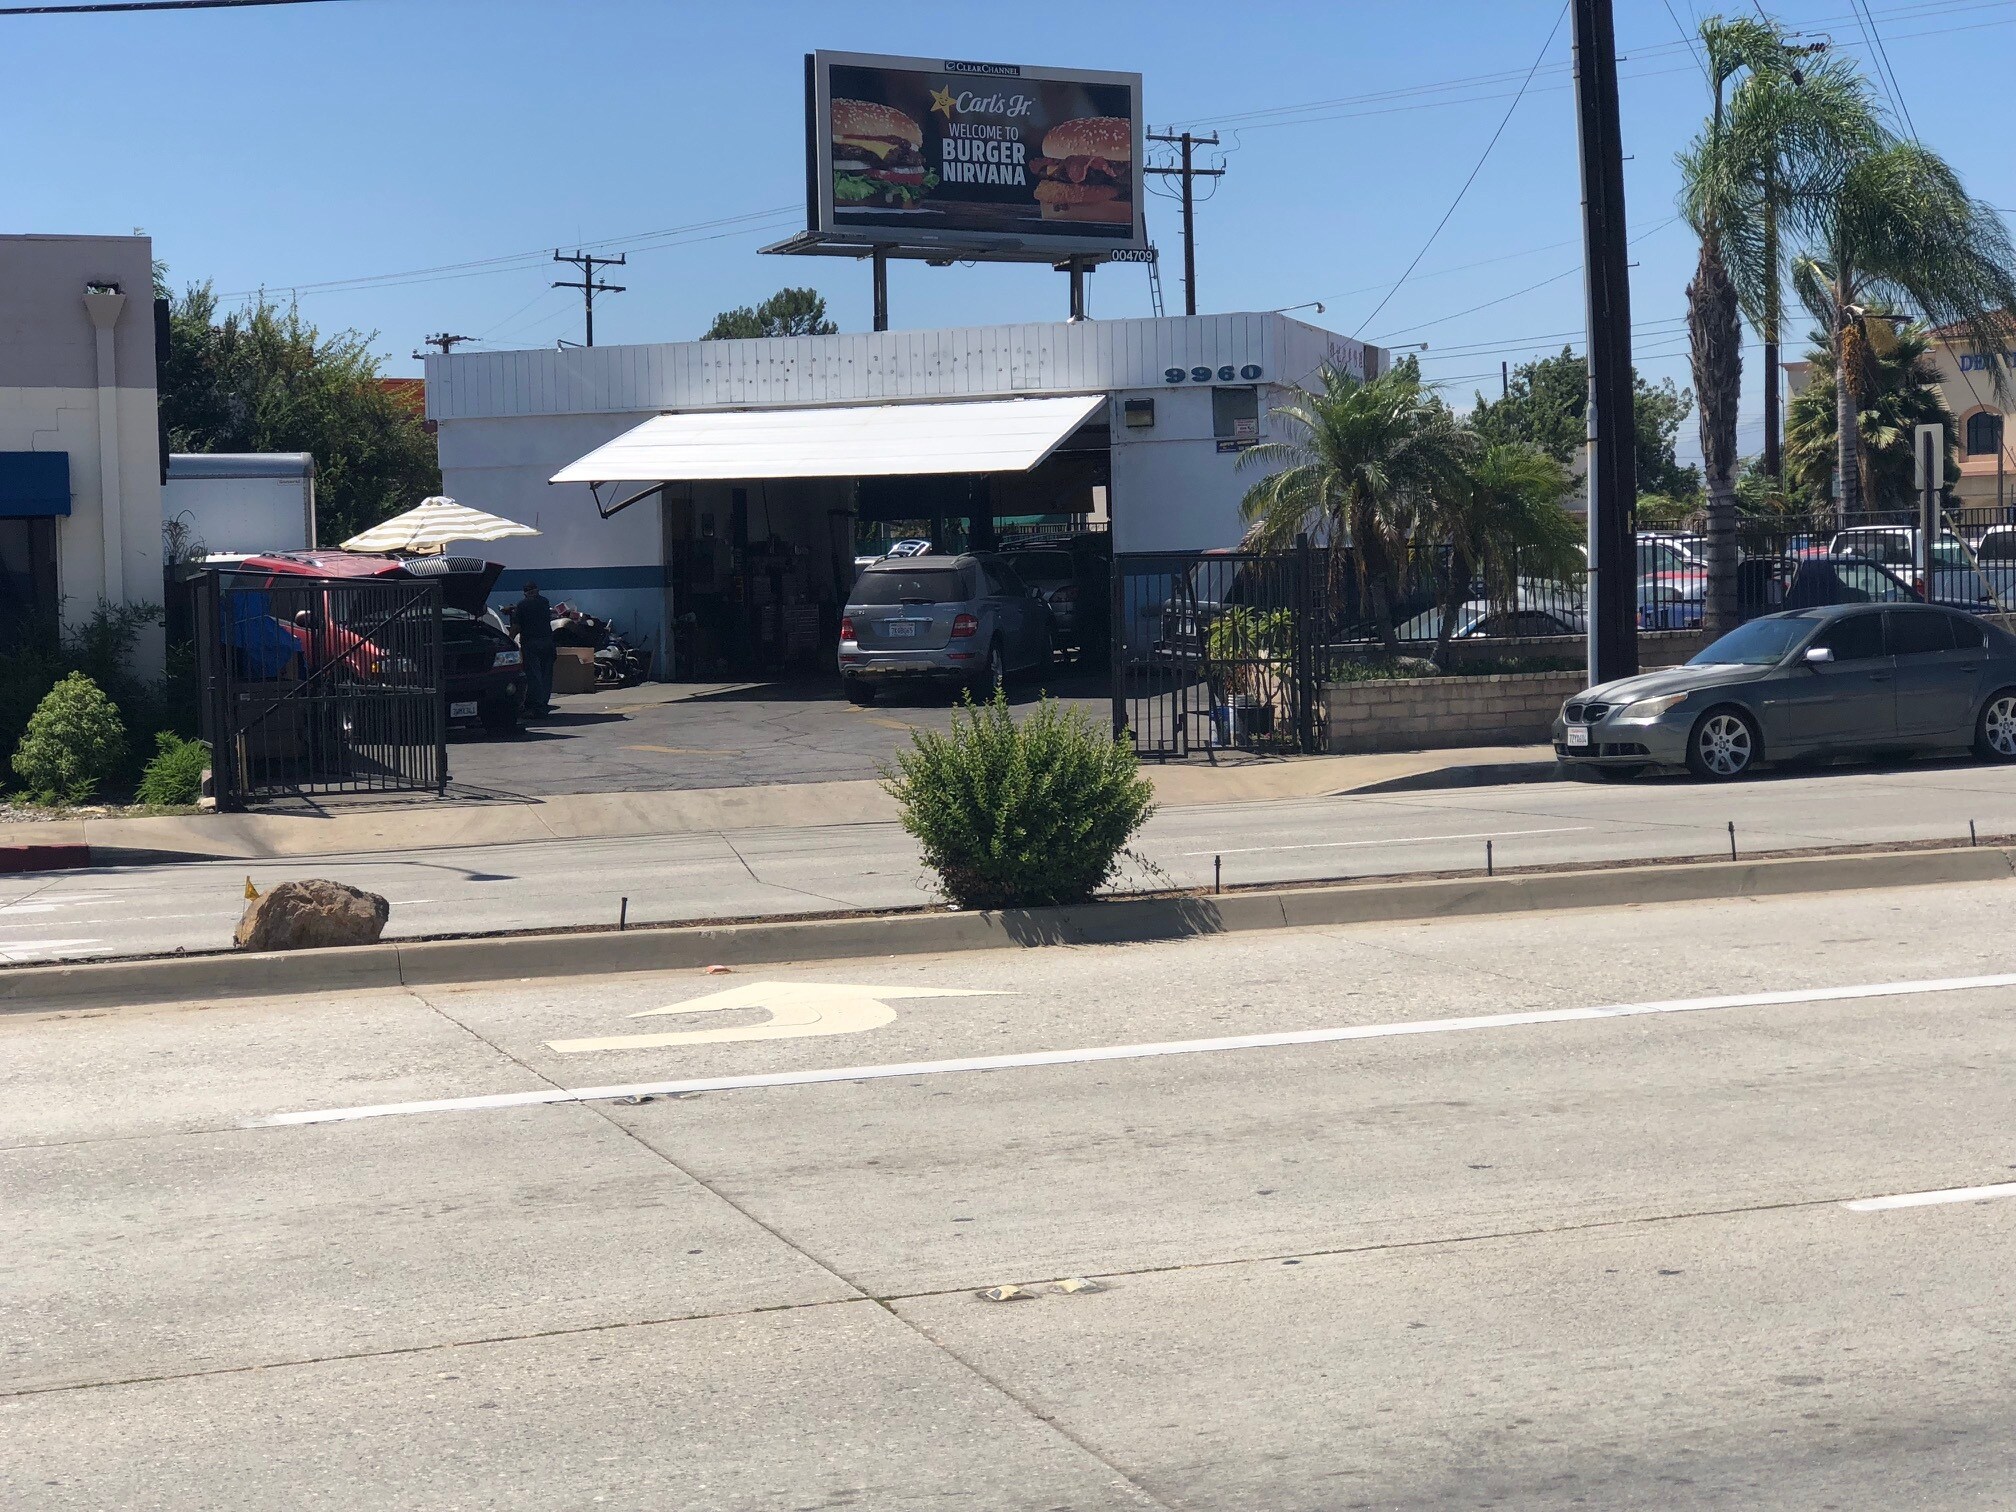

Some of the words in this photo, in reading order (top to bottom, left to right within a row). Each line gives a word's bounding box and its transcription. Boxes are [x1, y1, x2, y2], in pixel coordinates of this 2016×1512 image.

[955, 91, 1005, 114] Carl's
[1006, 95, 1032, 117] Jr.
[949, 122, 1002, 140] WELCOME
[1005, 126, 1019, 141] TO
[942, 138, 1026, 164] BURGER
[942, 161, 1026, 186] NIRVANA
[1112, 249, 1153, 262] 004709
[1165, 364, 1262, 384] 9960
